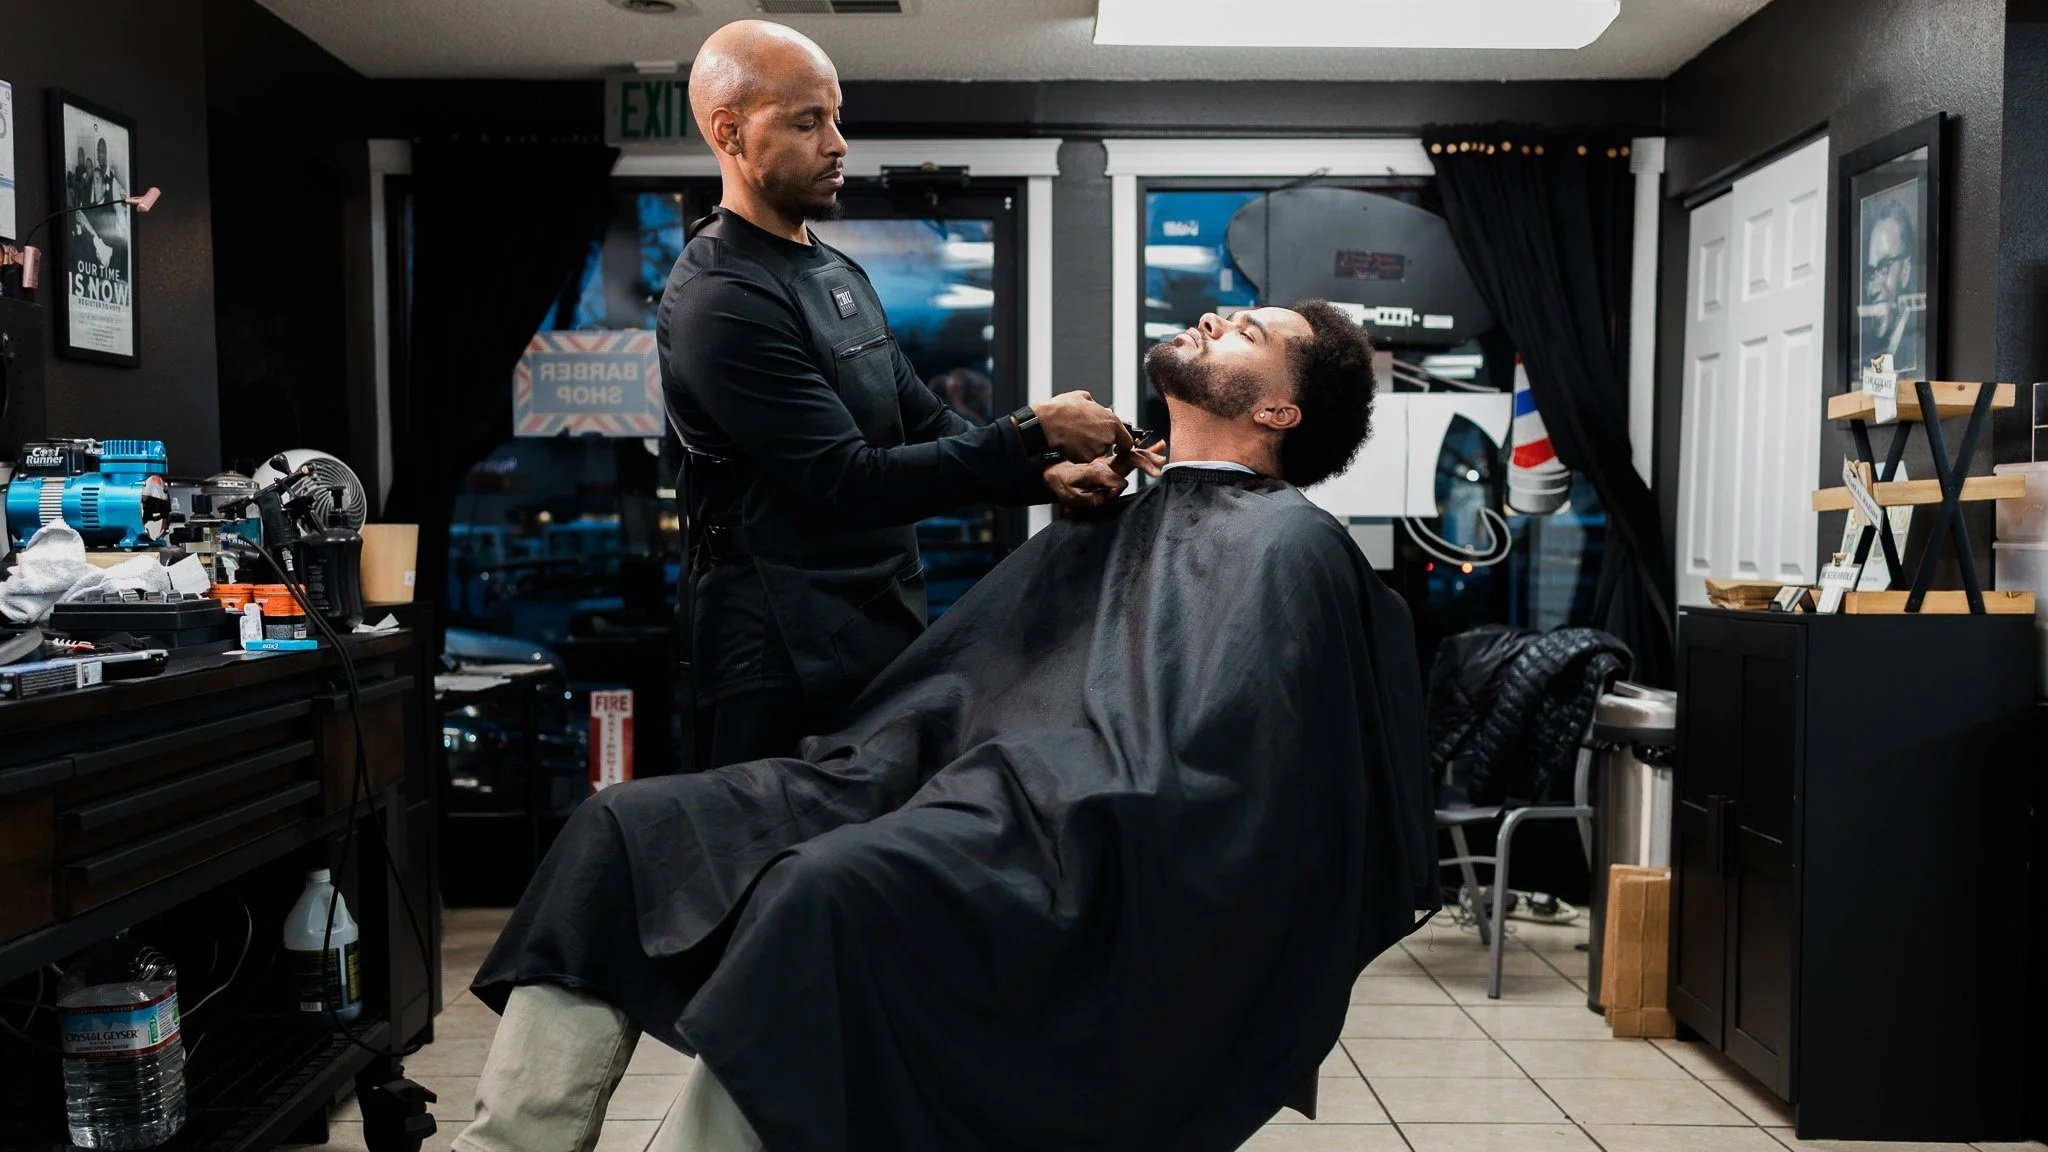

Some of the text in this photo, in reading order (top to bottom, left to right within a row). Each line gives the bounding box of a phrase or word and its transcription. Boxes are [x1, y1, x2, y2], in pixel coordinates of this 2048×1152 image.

[622, 81, 689, 137] EXIT
[78, 260, 120, 282] OUR TIME
[69, 271, 129, 308] IS NOW
[79, 298, 121, 313] REGISTER TO VOTE
[836, 291, 852, 306] TRU
[32, 447, 60, 457] Cool
[26, 455, 63, 465] Runner
[596, 695, 627, 711] FIRE
[66, 1029, 138, 1041] CRYSTAL GEYSER
